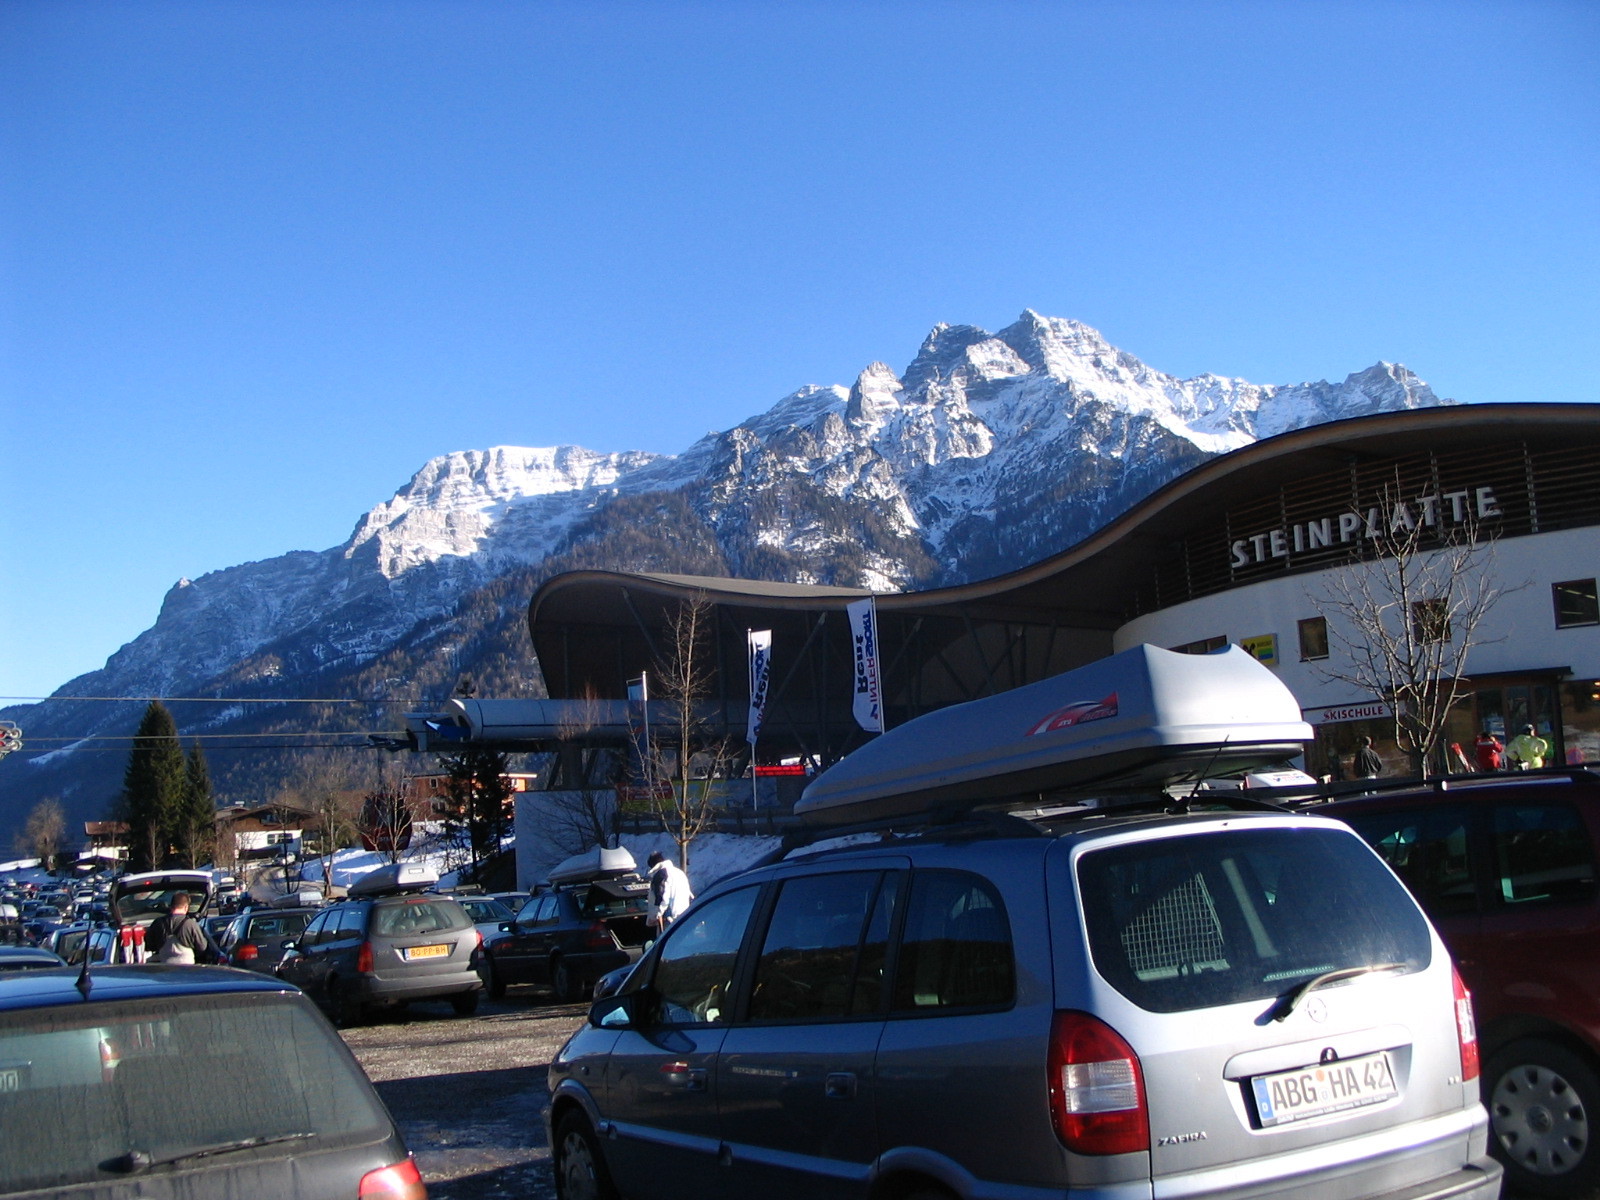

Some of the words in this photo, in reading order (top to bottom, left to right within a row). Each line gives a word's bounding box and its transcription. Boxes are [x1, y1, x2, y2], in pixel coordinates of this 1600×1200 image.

[1232, 487, 1502, 568] STEINPLATTE
[1324, 706, 1383, 720] SKISCHULE
[1271, 1073, 1318, 1111] ABG
[1328, 1066, 1361, 1099] HA
[1363, 1060, 1391, 1090] 42
